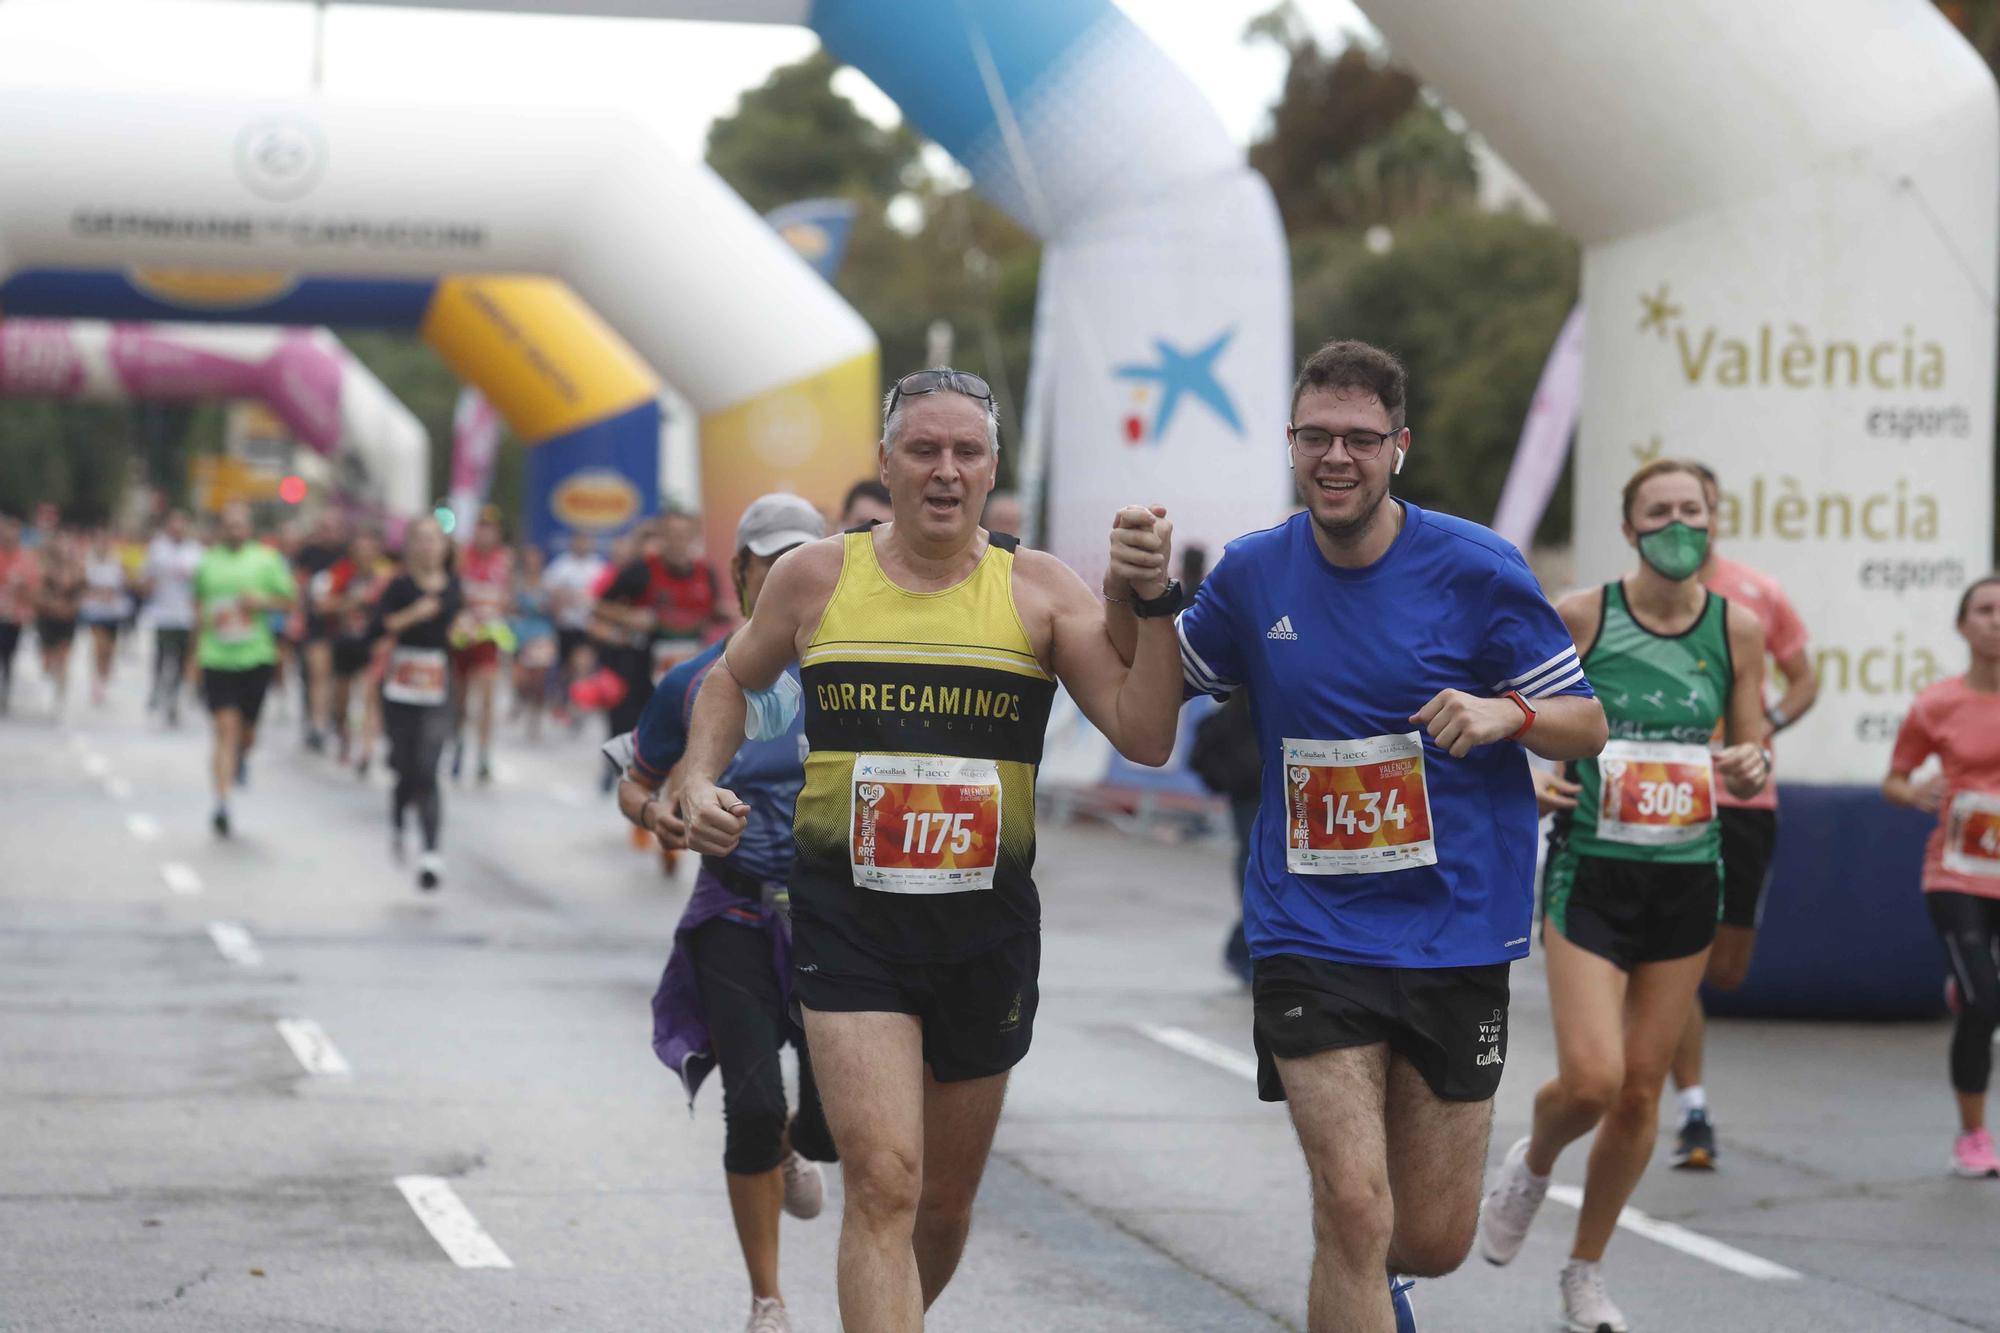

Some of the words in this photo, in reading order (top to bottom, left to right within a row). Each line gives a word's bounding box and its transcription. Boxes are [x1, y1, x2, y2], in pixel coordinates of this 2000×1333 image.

[1676, 324, 1947, 389] València
[1717, 476, 1940, 541] alència
[1266, 631, 1298, 641] adidas
[817, 683, 1020, 721] CORRECAMINOS
[874, 767, 907, 776] CaixaBank
[925, 768, 950, 777] aecc
[1342, 750, 1368, 760] aecc
[1322, 788, 1407, 835] 1434
[1637, 781, 1694, 816] 306
[858, 846, 875, 857] RRE
[902, 812, 974, 855] 1175
